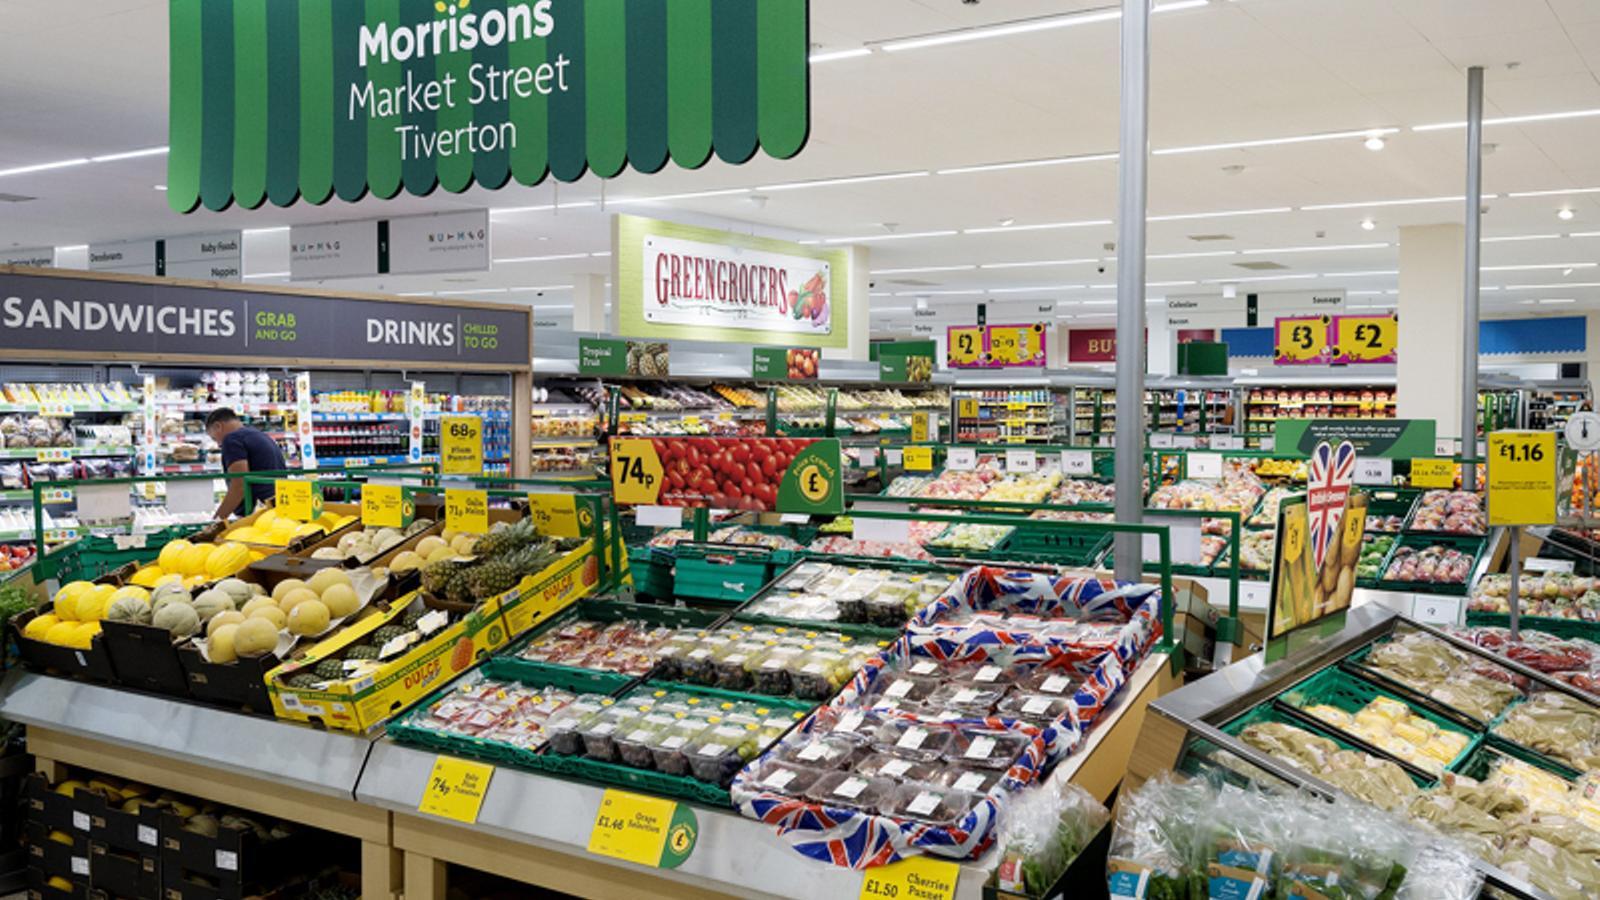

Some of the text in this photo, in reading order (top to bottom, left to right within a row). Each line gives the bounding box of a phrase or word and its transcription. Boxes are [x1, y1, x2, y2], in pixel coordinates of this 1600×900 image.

[359, 0, 554, 67] Morrisons
[349, 53, 570, 120] Market Street
[395, 121, 516, 160] Tiverton
[656, 252, 788, 315] GREENGROCERS
[2, 296, 237, 337] SANDWICHES
[255, 312, 296, 327] GRAB
[256, 329, 296, 341] AND GO
[367, 318, 455, 346] DRINKS
[464, 323, 498, 336] CHILLED
[1292, 326, 1313, 349] £3
[1354, 324, 1383, 348] £2
[464, 336, 498, 349] TO GO
[958, 333, 974, 354] £2
[1088, 338, 1117, 353] BU
[450, 423, 477, 439] 68p
[1500, 443, 1544, 462] £1.16
[616, 456, 654, 490] 74p
[404, 659, 441, 690] DULCE
[627, 819, 660, 833] Selection
[635, 811, 657, 823] Grape
[865, 879, 899, 898] £1.50
[907, 873, 950, 892] Cherries
[908, 885, 944, 900] Punnet
